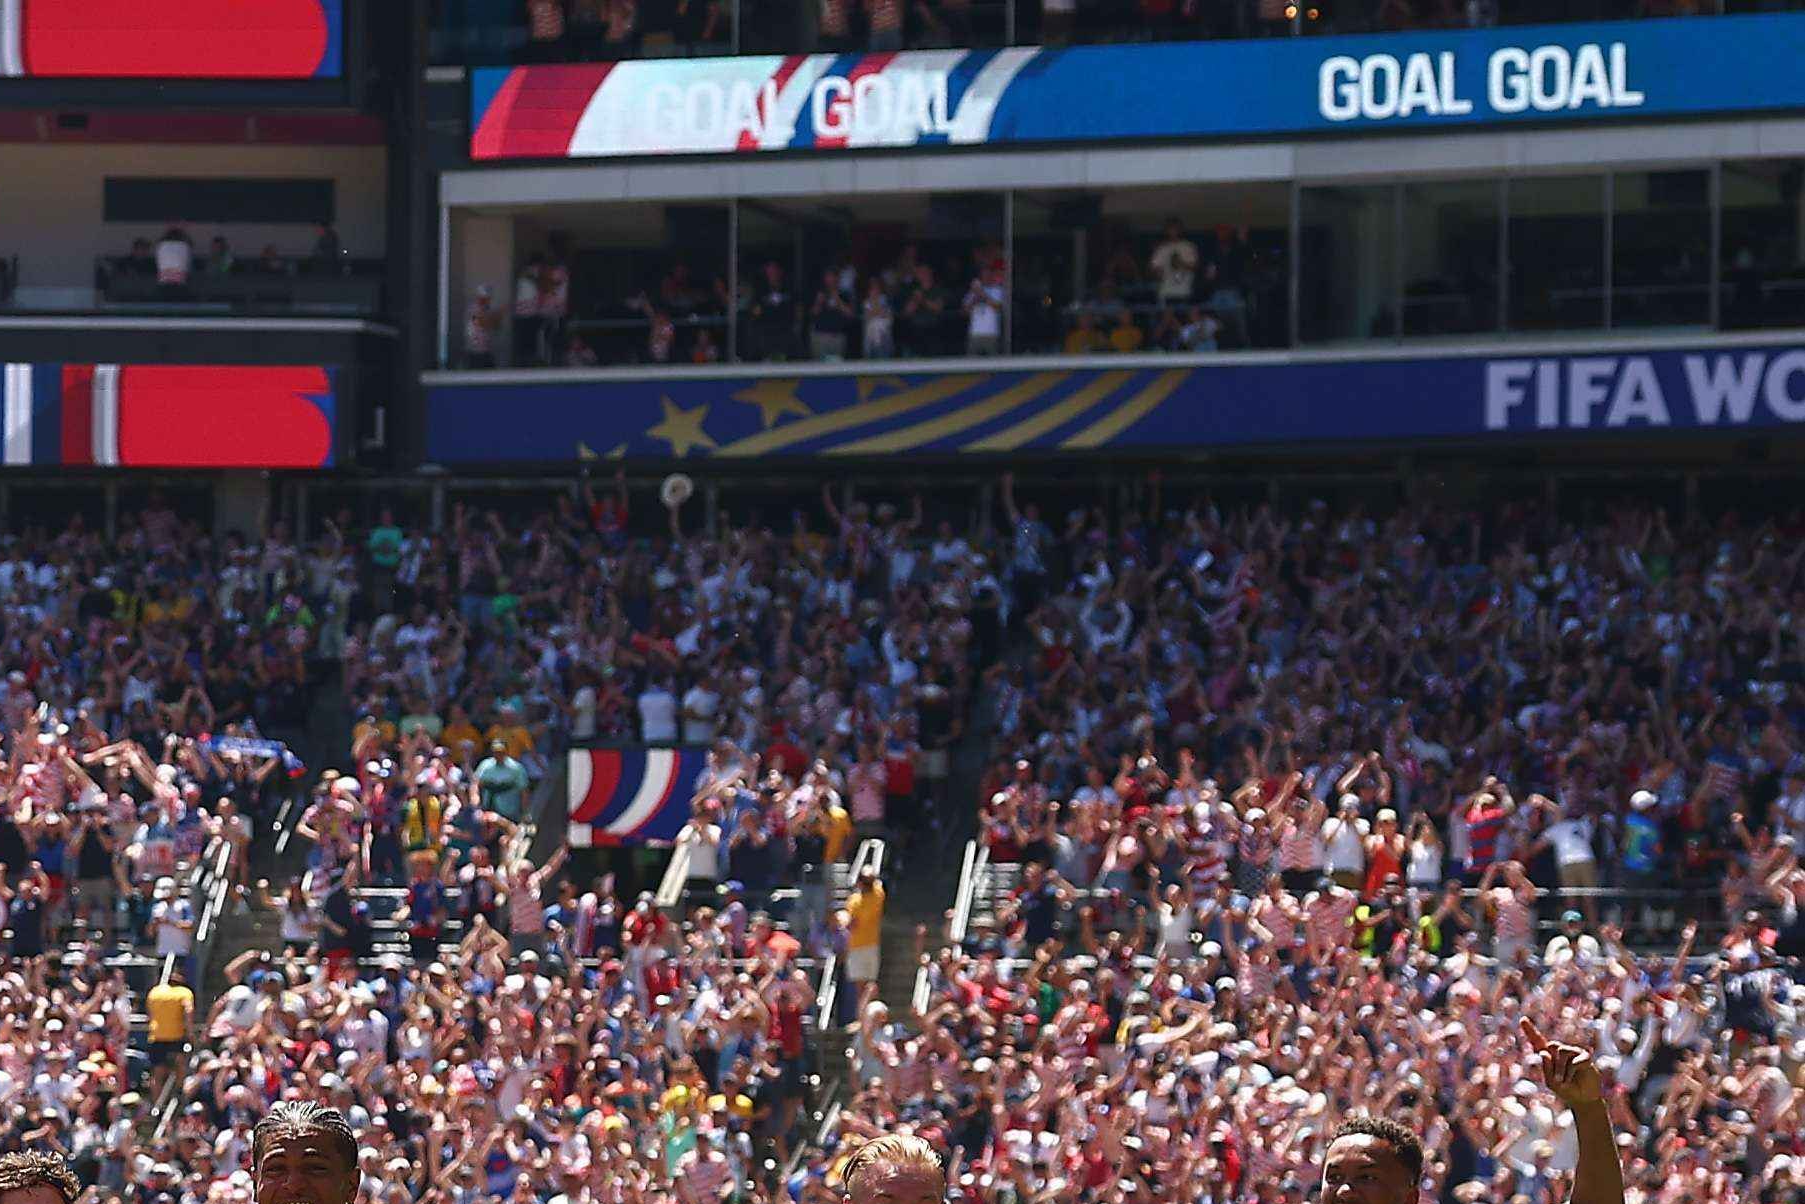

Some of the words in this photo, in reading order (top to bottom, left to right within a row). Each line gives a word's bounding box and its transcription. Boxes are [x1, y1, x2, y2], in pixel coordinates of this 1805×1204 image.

[644, 77, 790, 137] GOAL
[812, 72, 964, 138] GOAL
[1319, 51, 1473, 121] GOAL
[1488, 42, 1645, 113] GOAL
[1486, 355, 1672, 429] FIFA
